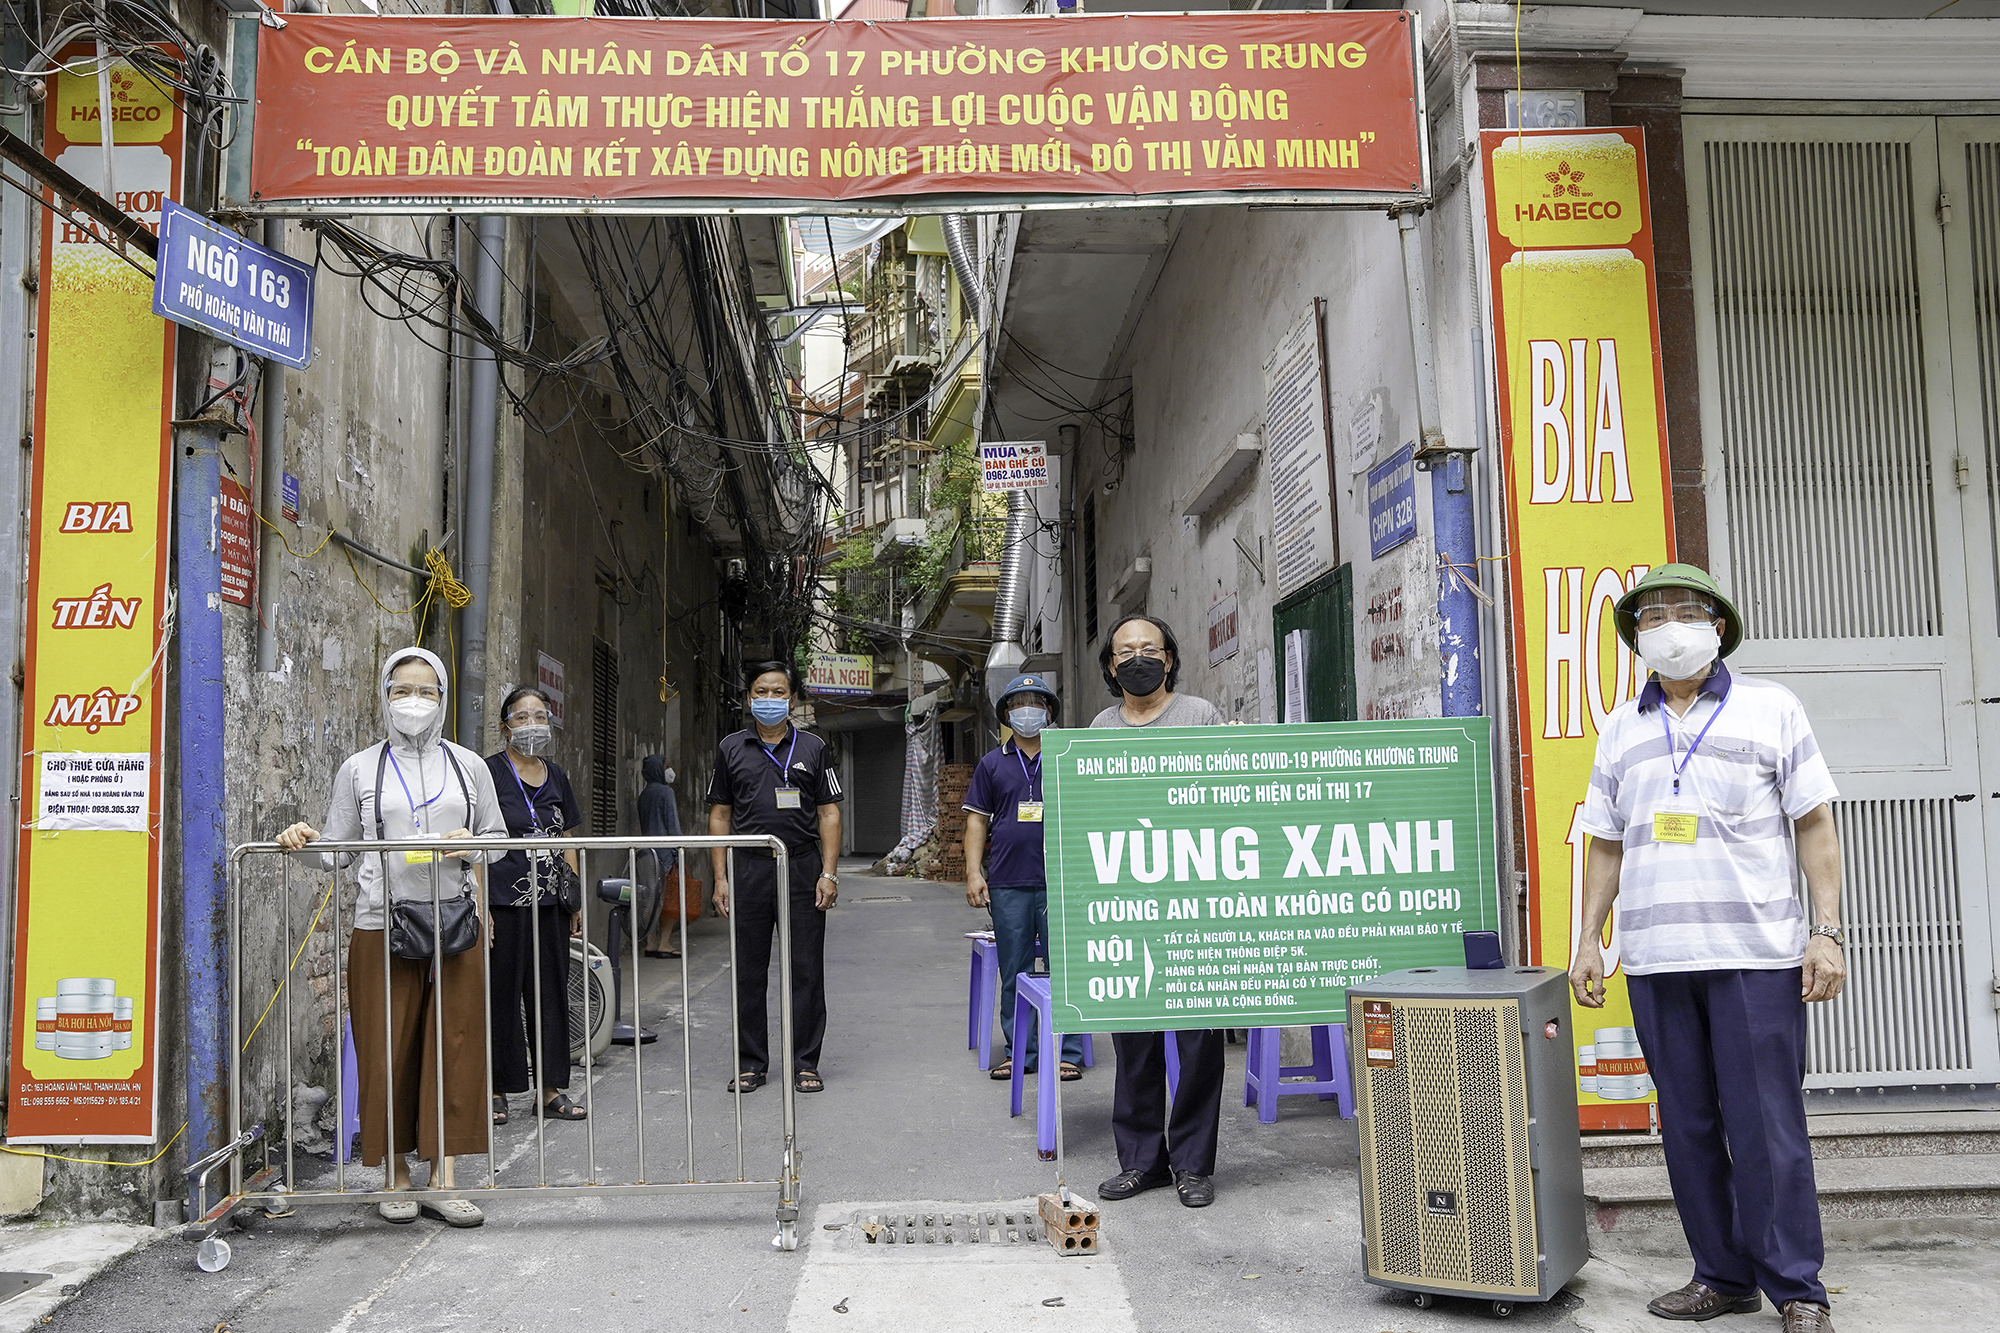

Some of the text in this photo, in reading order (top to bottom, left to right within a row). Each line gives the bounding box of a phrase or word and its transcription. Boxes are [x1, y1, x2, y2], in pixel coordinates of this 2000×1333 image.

[304, 37, 1367, 82] CÁN BỘ VÀ NHÂN DÂN TỔ 17 PHƯỜNG KHƯƠNG TRUNG
[387, 83, 1288, 135] QUYẾT TÂM THỰC HIỆN THẮNG LỢI CUỘC VẬN ĐỘNG
[409, 140, 473, 176] DÂN
[484, 140, 572, 176] ĐOÀN
[584, 137, 641, 177] KẾT
[651, 141, 712, 176] XÂY
[724, 144, 809, 182] DỰNG
[820, 141, 907, 177] NÔNG
[918, 139, 999, 174] THÔN
[1012, 137, 1081, 176] MỚI,
[1091, 137, 1133, 172] ĐÔ
[1143, 141, 1191, 176] THỊ
[1202, 133, 1265, 169] VĂN
[1515, 201, 1622, 222] HABECO
[187, 234, 291, 309] NGÕ 163
[179, 281, 291, 348] PHỐ HOÀNG THÁI
[1529, 339, 1634, 505] BIA
[984, 447, 1017, 459] MUA
[985, 456, 1045, 470] BÀN GHẾ CŨ
[986, 468, 1046, 480] 0962.40.9982
[60, 502, 133, 533] BIA
[1373, 496, 1413, 543] CHPN 32B
[52, 583, 142, 629] TIẾN
[809, 663, 836, 684] NHÀ
[44, 687, 141, 734] MẬP
[47, 761, 66, 771] CHO
[69, 759, 93, 771] THUÊ
[117, 759, 144, 771] HÀNG
[1077, 746, 1458, 777] BAN CHỈ ĐẠO PHÒNG CHỐNG COVID-19 PHƯỜNG KHƯƠNG TRUNG
[1168, 777, 1372, 806] CHỐT THỰC HIỆN CHỈ THỊ 17
[1087, 819, 1455, 884] VÙNG XANH
[1088, 887, 1461, 925] (VÙNG AN TOÀN KHÔNG CÓ DỊCH)
[1164, 919, 1466, 945] TẤT CẢ NGƯỜI LẠ, KHÁCH RA VÀO ĐỀU PHẢI KHAI BÁO Y TẾ.
[1087, 935, 1140, 1002] NỘI QUY
[1165, 955, 1381, 977] HÀNG HÓA CHỈ NHẬN TẠI BÀN TRỰC CHỐT.
[1167, 945, 1307, 962] THỰC HIỆN THÔNG ĐIỆP 5K.
[1166, 973, 1346, 993] MỖI CÁ NHÂN ĐỀU PHẢI CÓ Ý THỨC
[1166, 992, 1297, 1009] GIA ĐÌNH VÀ CỘNG ĐỒNG.
[58, 1017, 69, 1028] BIA
[94, 1082, 113, 1091] THANH
